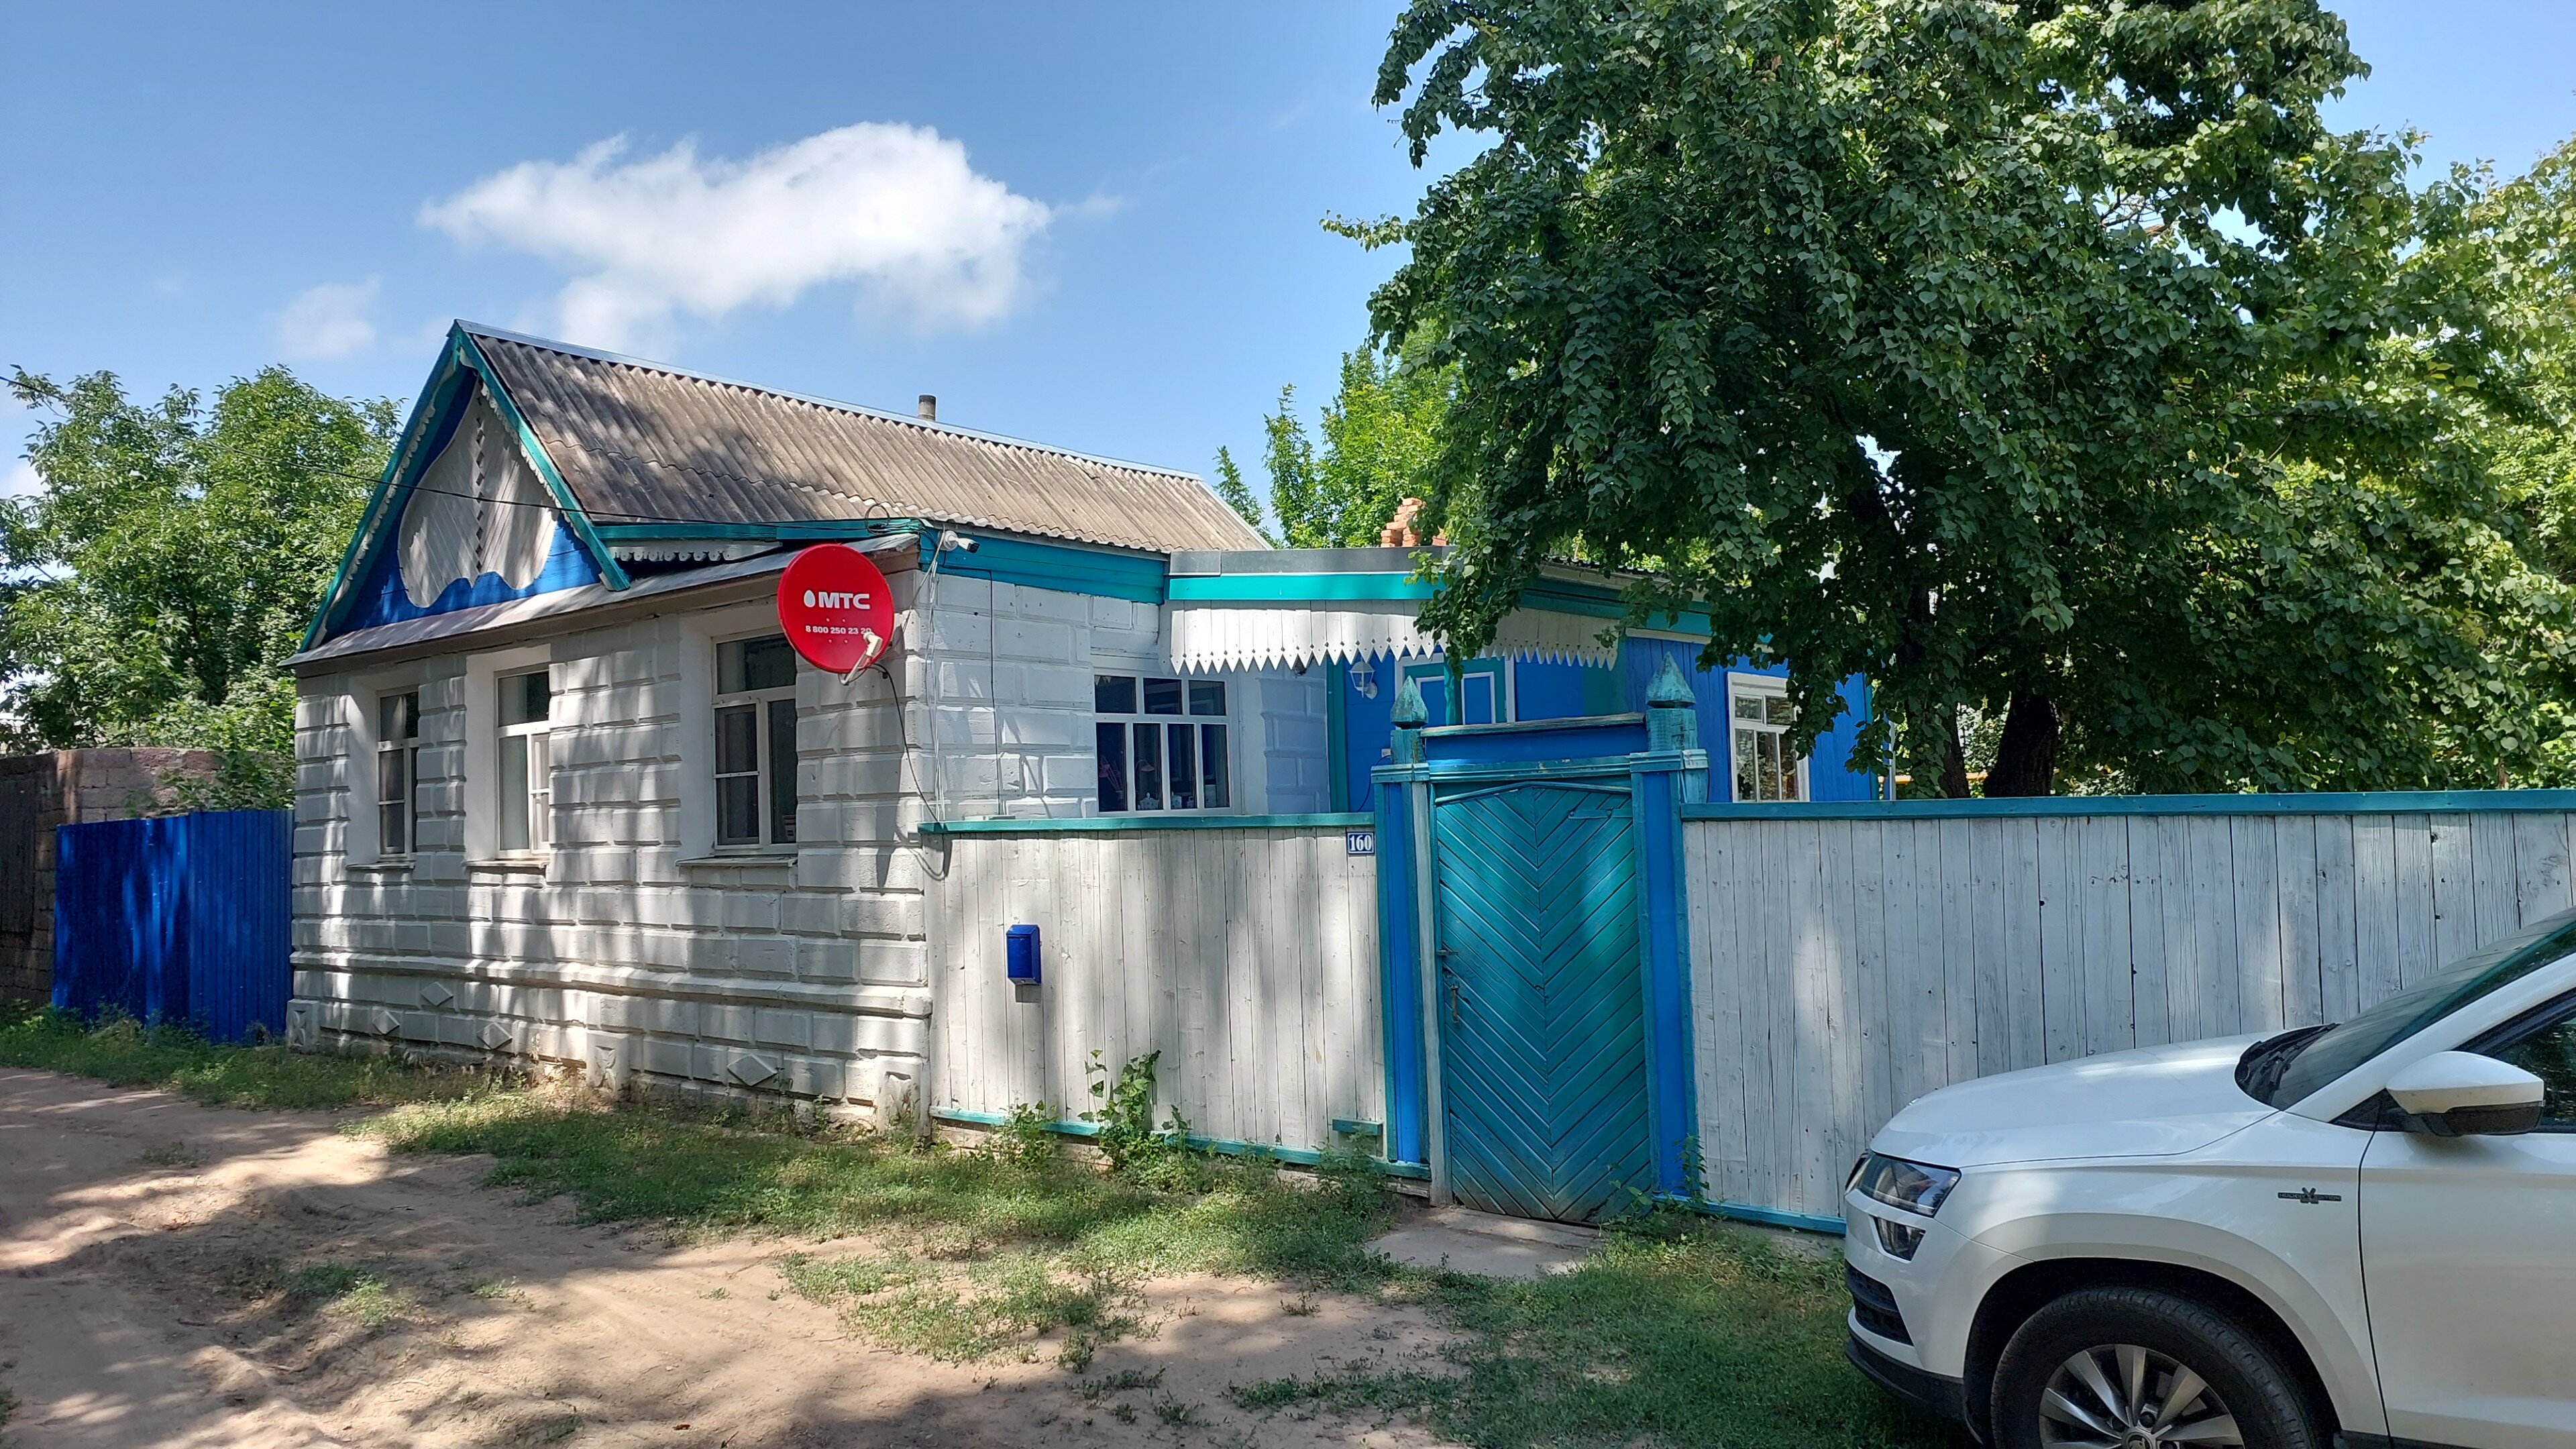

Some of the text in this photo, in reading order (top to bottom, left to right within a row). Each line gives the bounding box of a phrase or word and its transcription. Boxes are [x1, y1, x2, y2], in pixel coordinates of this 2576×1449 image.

[818, 592, 870, 609] МТС
[805, 625, 811, 633] 8
[812, 626, 828, 634] 800
[830, 627, 847, 635] 250
[1349, 835, 1372, 851] 160
